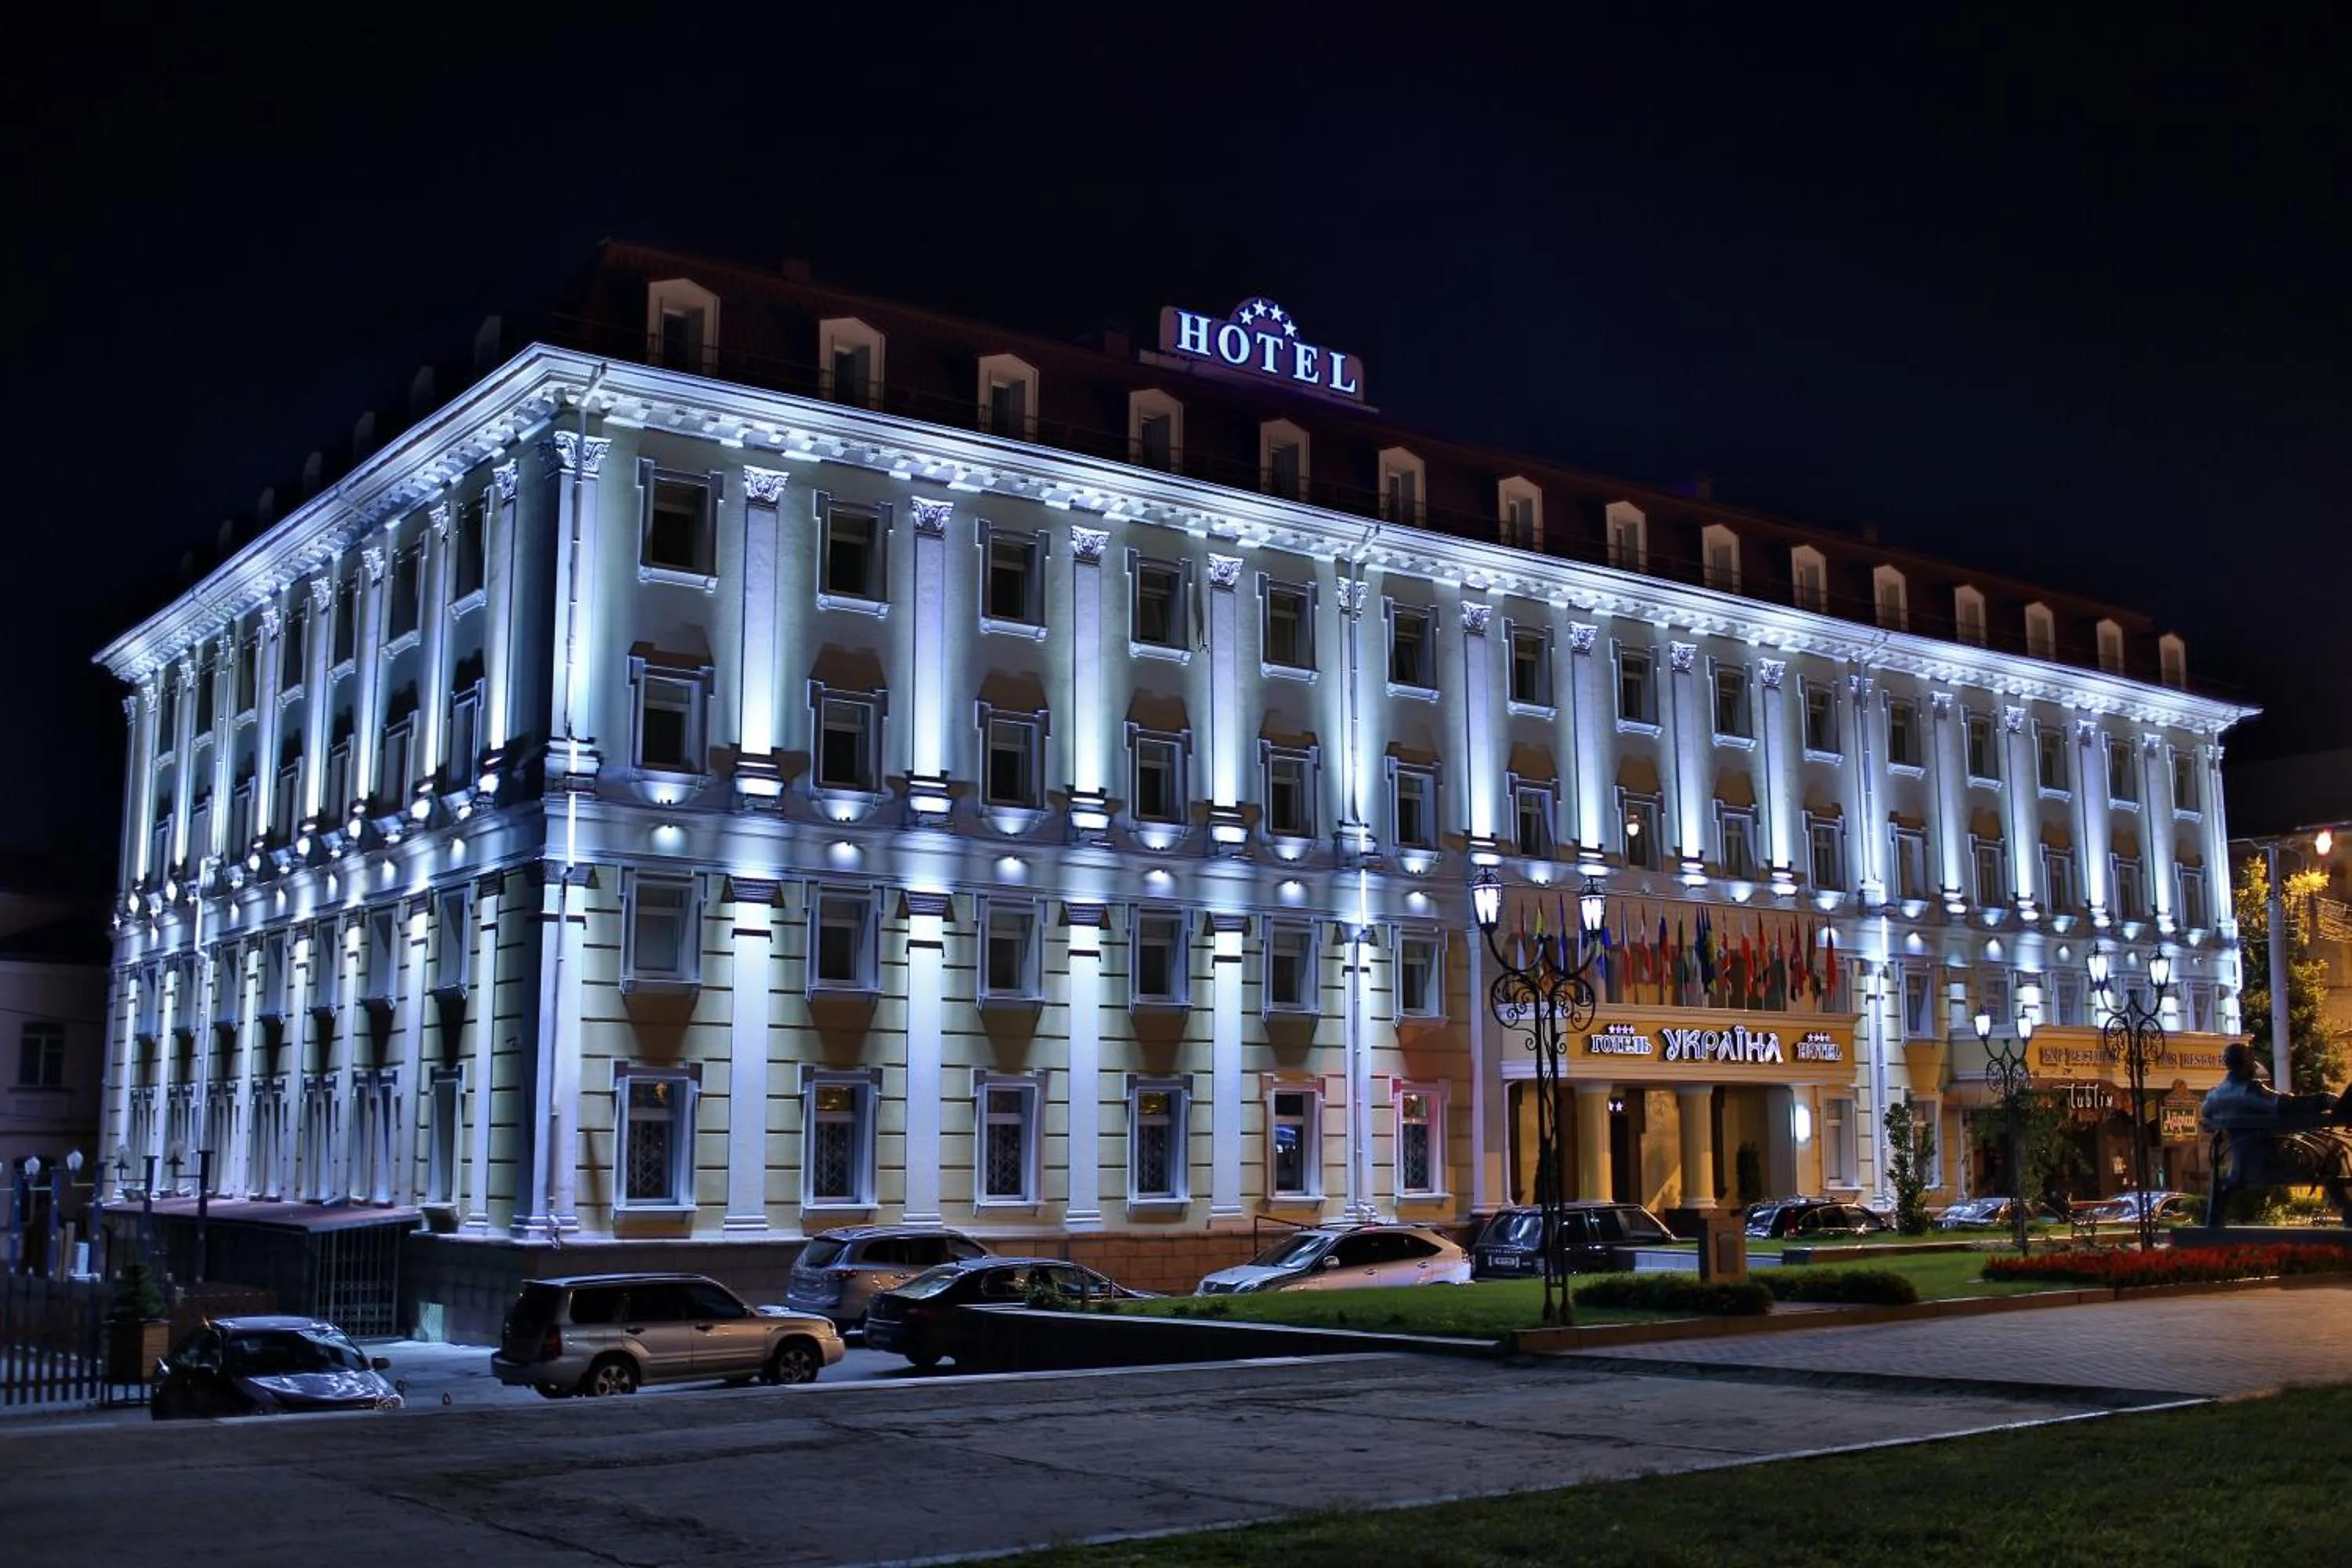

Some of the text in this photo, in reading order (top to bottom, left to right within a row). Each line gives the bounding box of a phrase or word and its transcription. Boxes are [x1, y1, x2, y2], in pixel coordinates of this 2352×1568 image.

[1176, 311, 1356, 394] HOTEL
[1592, 1025, 1784, 1063] ГОТЕЛЬ УКРАЇНА
[1797, 1042, 1842, 1061] HOTEL
